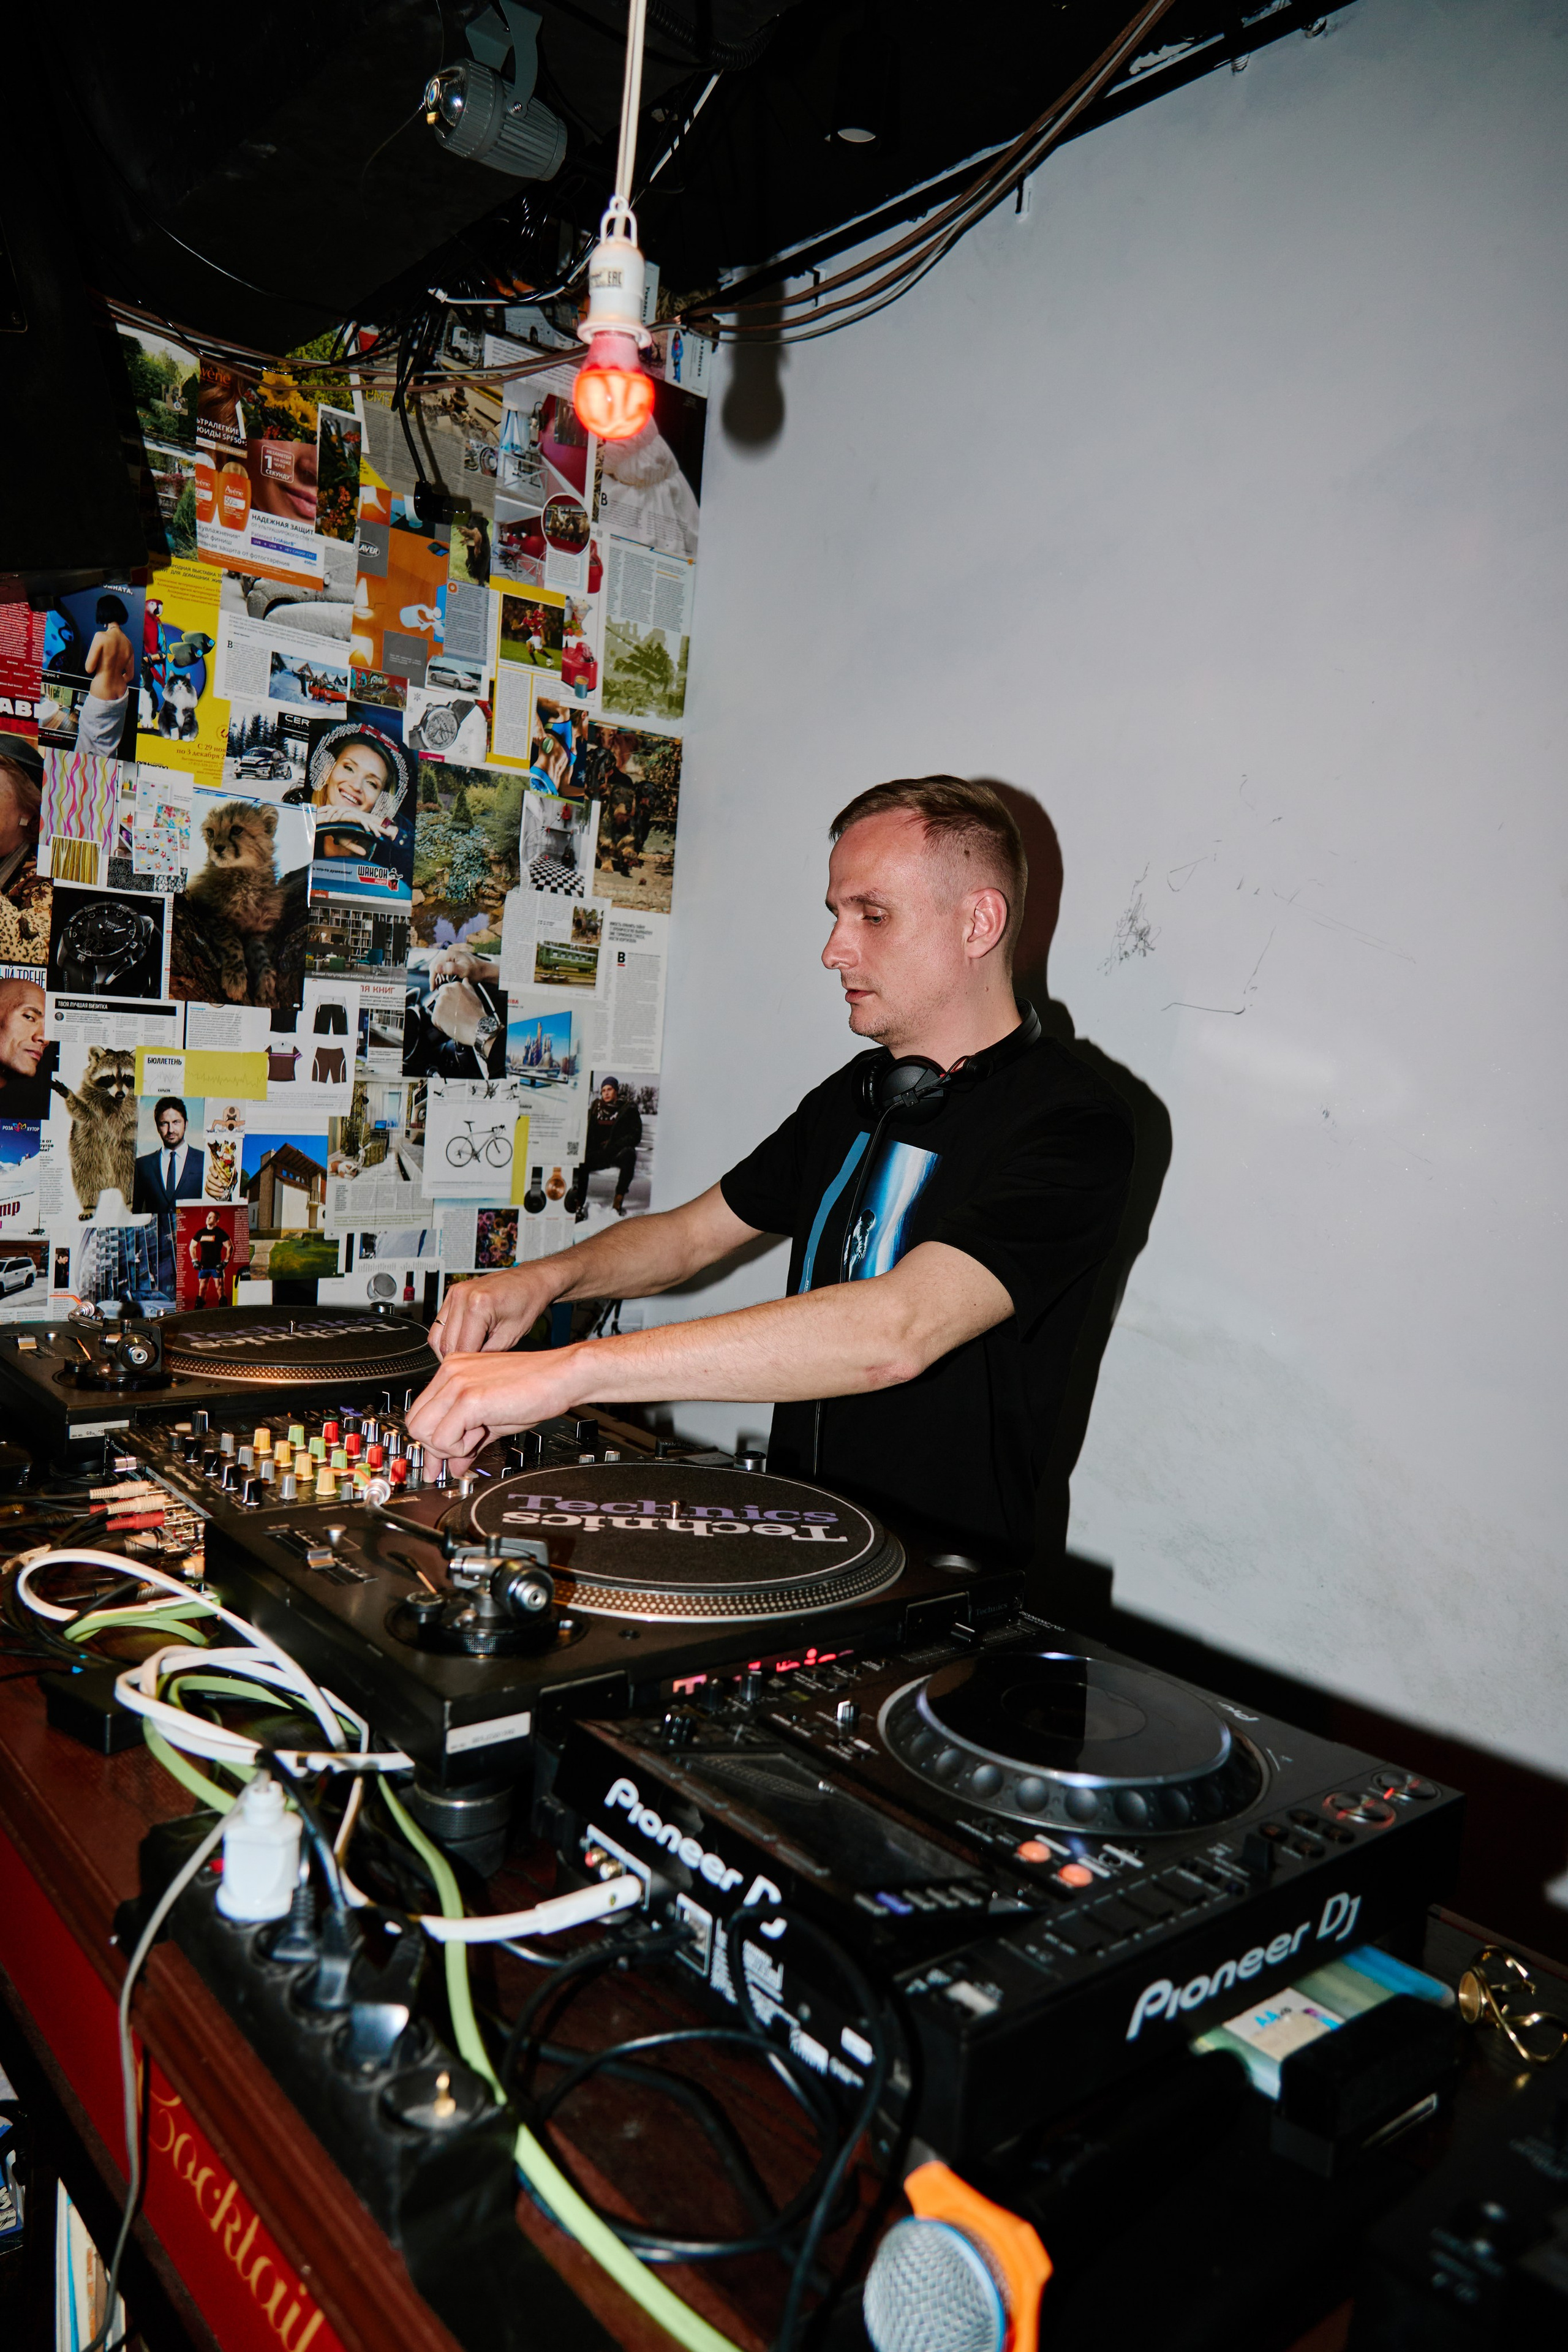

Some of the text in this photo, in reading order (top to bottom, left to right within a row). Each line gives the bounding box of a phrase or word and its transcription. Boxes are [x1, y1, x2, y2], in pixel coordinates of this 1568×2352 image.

[200, 368, 232, 385] vène
[264, 454, 273, 469] 1
[252, 514, 289, 529] НАДЕЖНАЯ
[192, 751, 220, 760] декабря
[358, 865, 388, 879] ШАНСОН
[104, 920, 121, 929] TISSOT
[147, 1057, 182, 1066] БЮЛЛЕТЕНЬ
[178, 1317, 383, 1341] Technics
[190, 1323, 409, 1348] Technics
[508, 1493, 839, 1523] Technics
[502, 1510, 848, 1542] Technics
[976, 1601, 1009, 1616] Technics
[603, 1777, 743, 1891] Pioneer
[1125, 1892, 1362, 2042] Pioneer DJ
